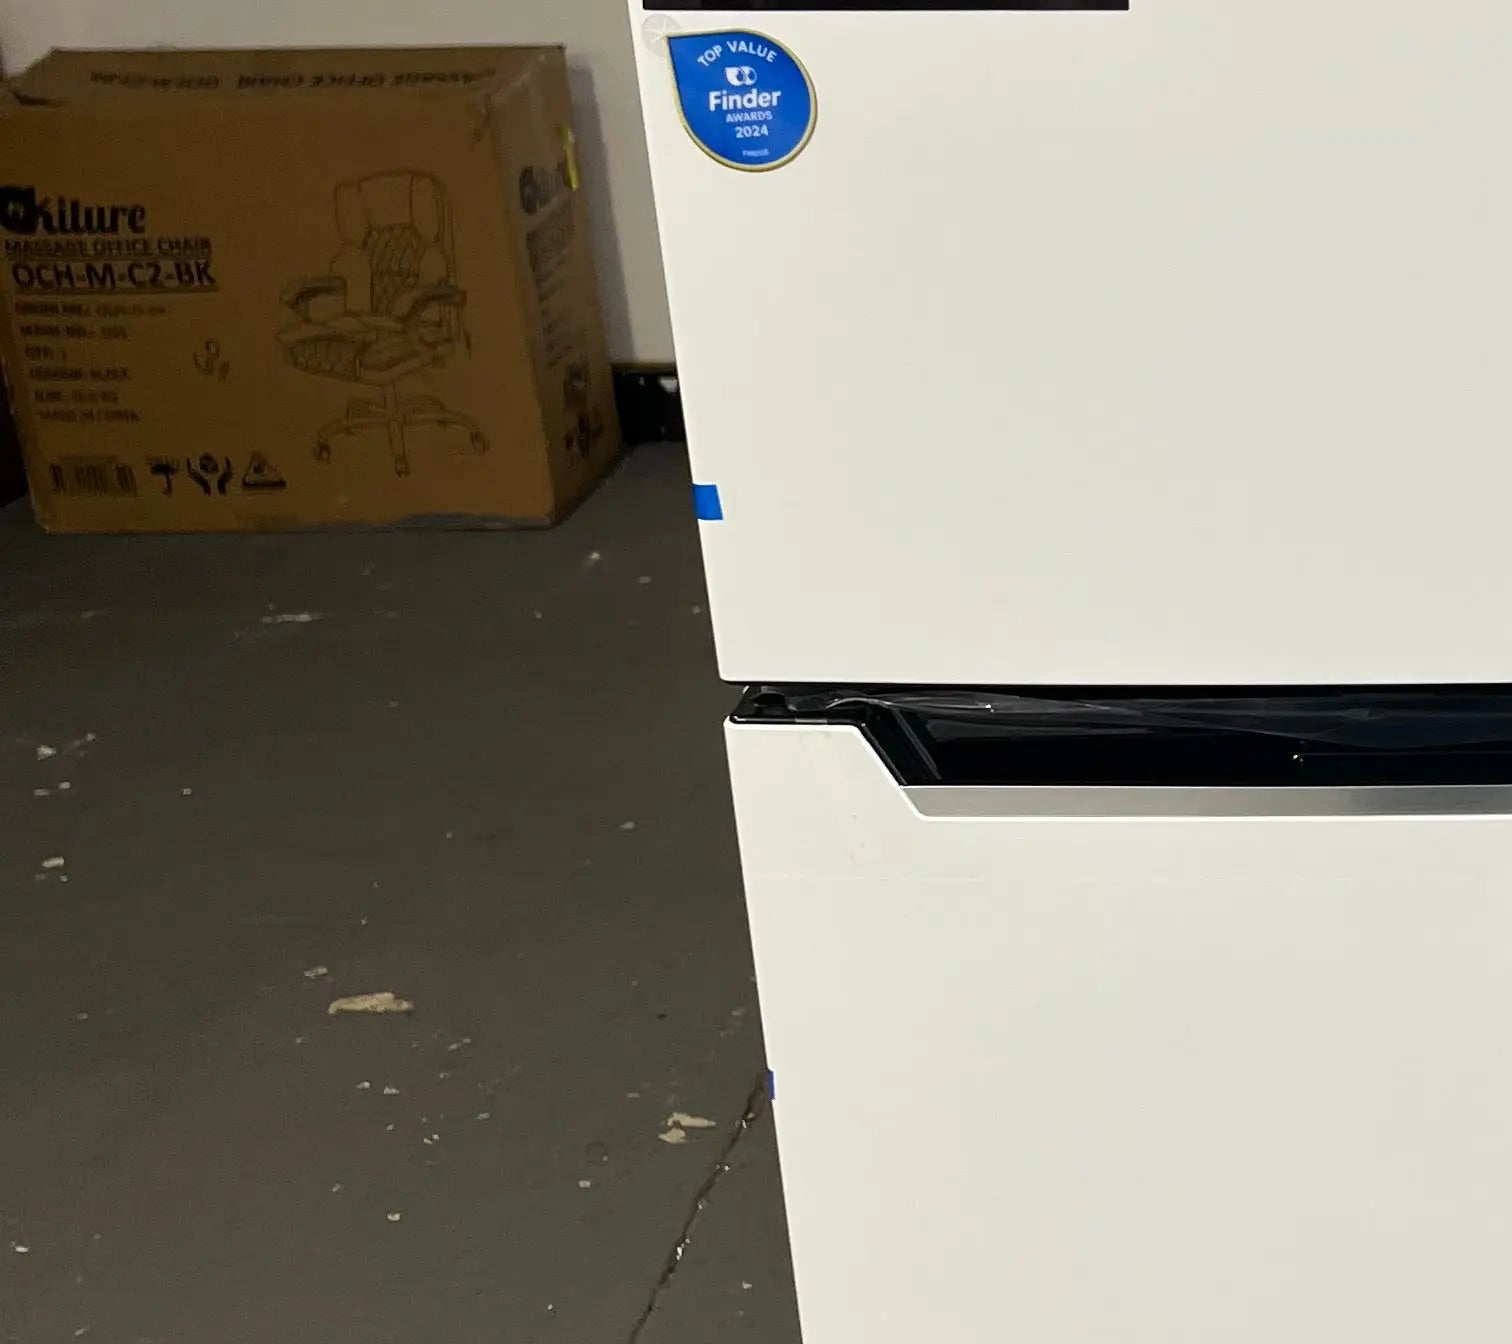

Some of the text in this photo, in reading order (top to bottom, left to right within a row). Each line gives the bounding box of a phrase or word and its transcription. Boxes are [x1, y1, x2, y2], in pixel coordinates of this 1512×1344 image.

[697, 40, 778, 67] TOP VALUE
[709, 88, 783, 112] Finder
[725, 110, 773, 123] AWARDS
[735, 124, 769, 138] 2024
